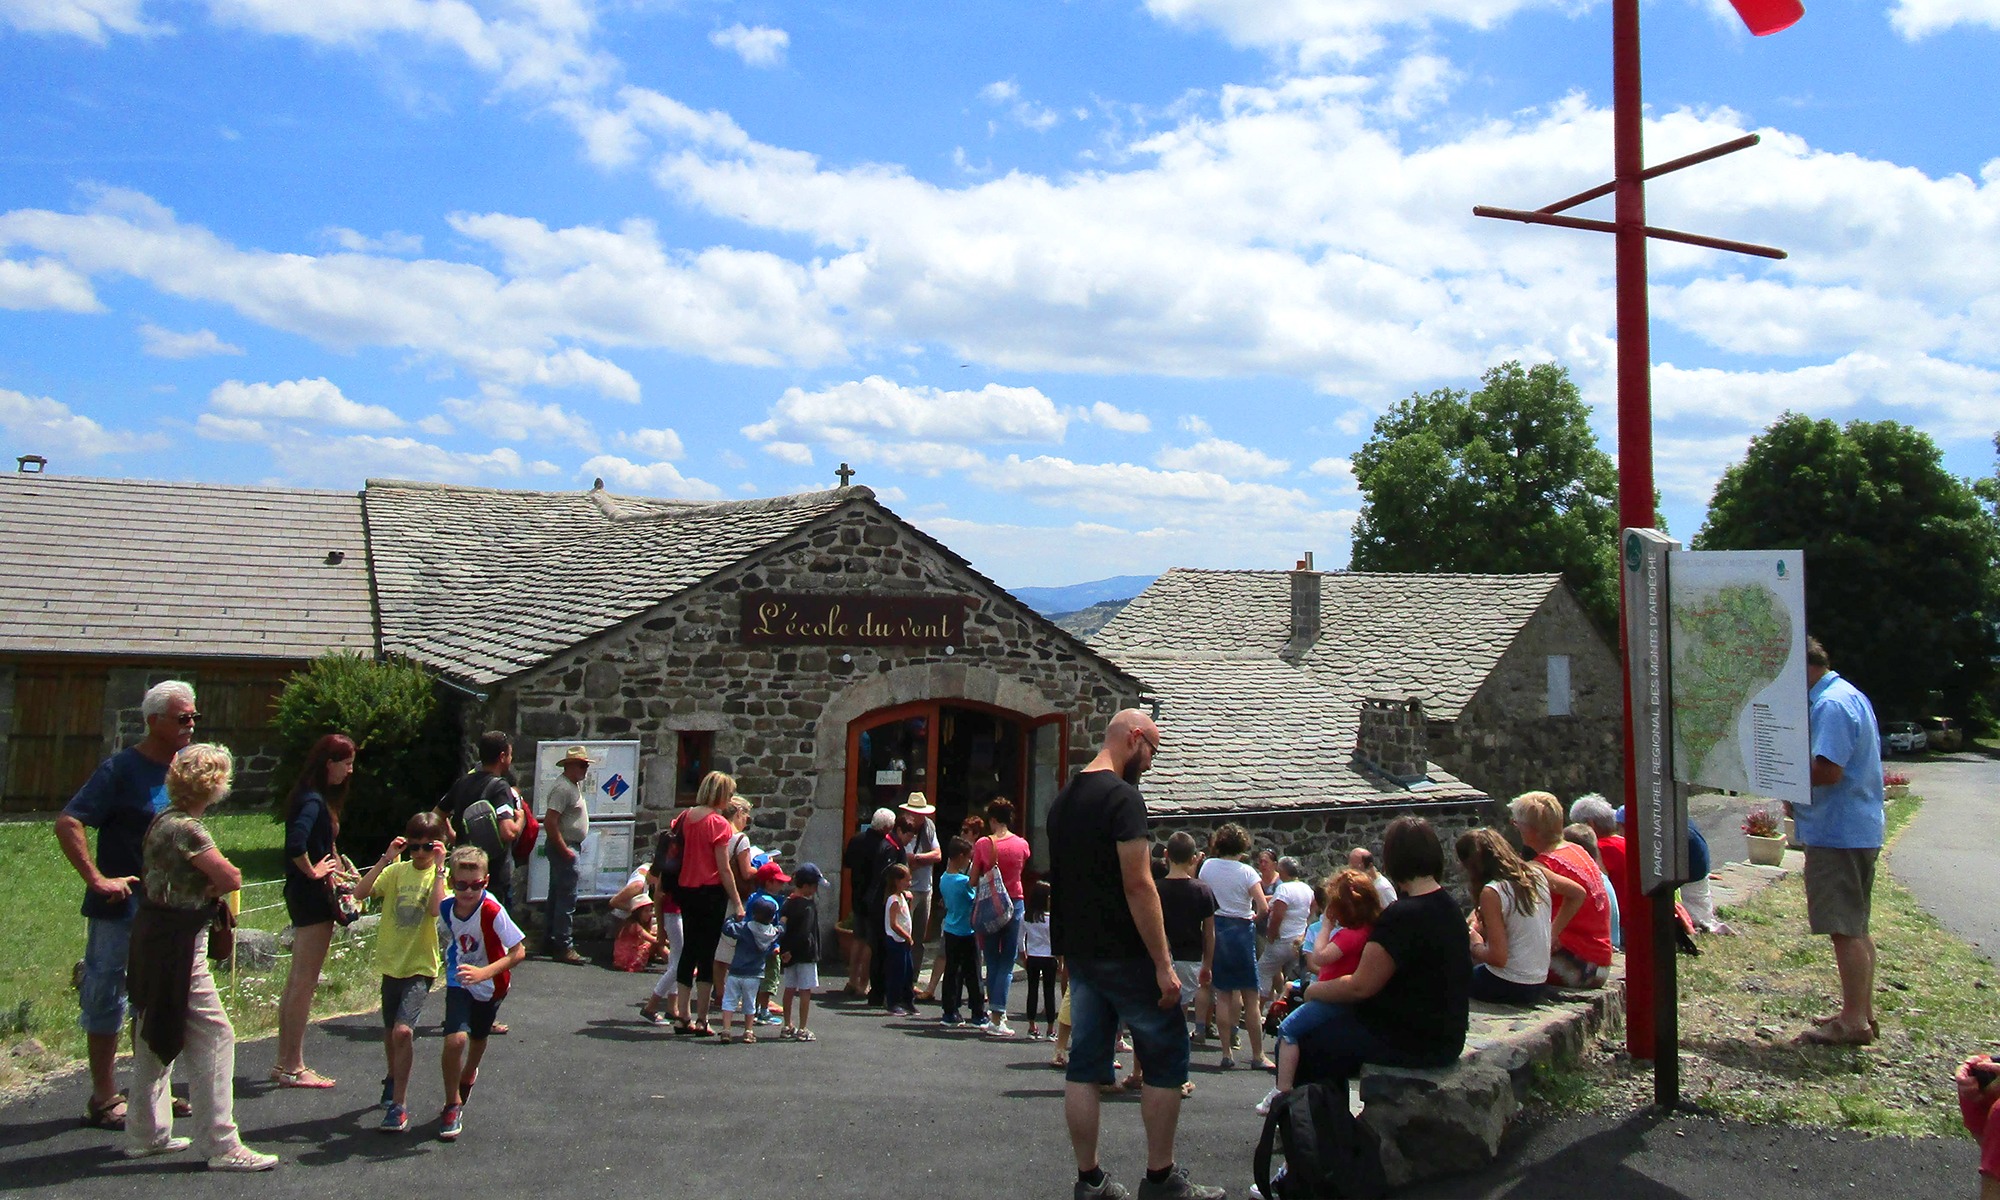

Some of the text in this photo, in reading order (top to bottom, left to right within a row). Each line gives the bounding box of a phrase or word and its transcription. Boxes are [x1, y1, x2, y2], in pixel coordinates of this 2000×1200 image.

[753, 602, 954, 639] L'école du vent
[1649, 629, 1659, 676] MONTS
[1650, 679, 1660, 705] DES
[1652, 778, 1662, 838] NATUREL
[1653, 840, 1663, 877] PARC
